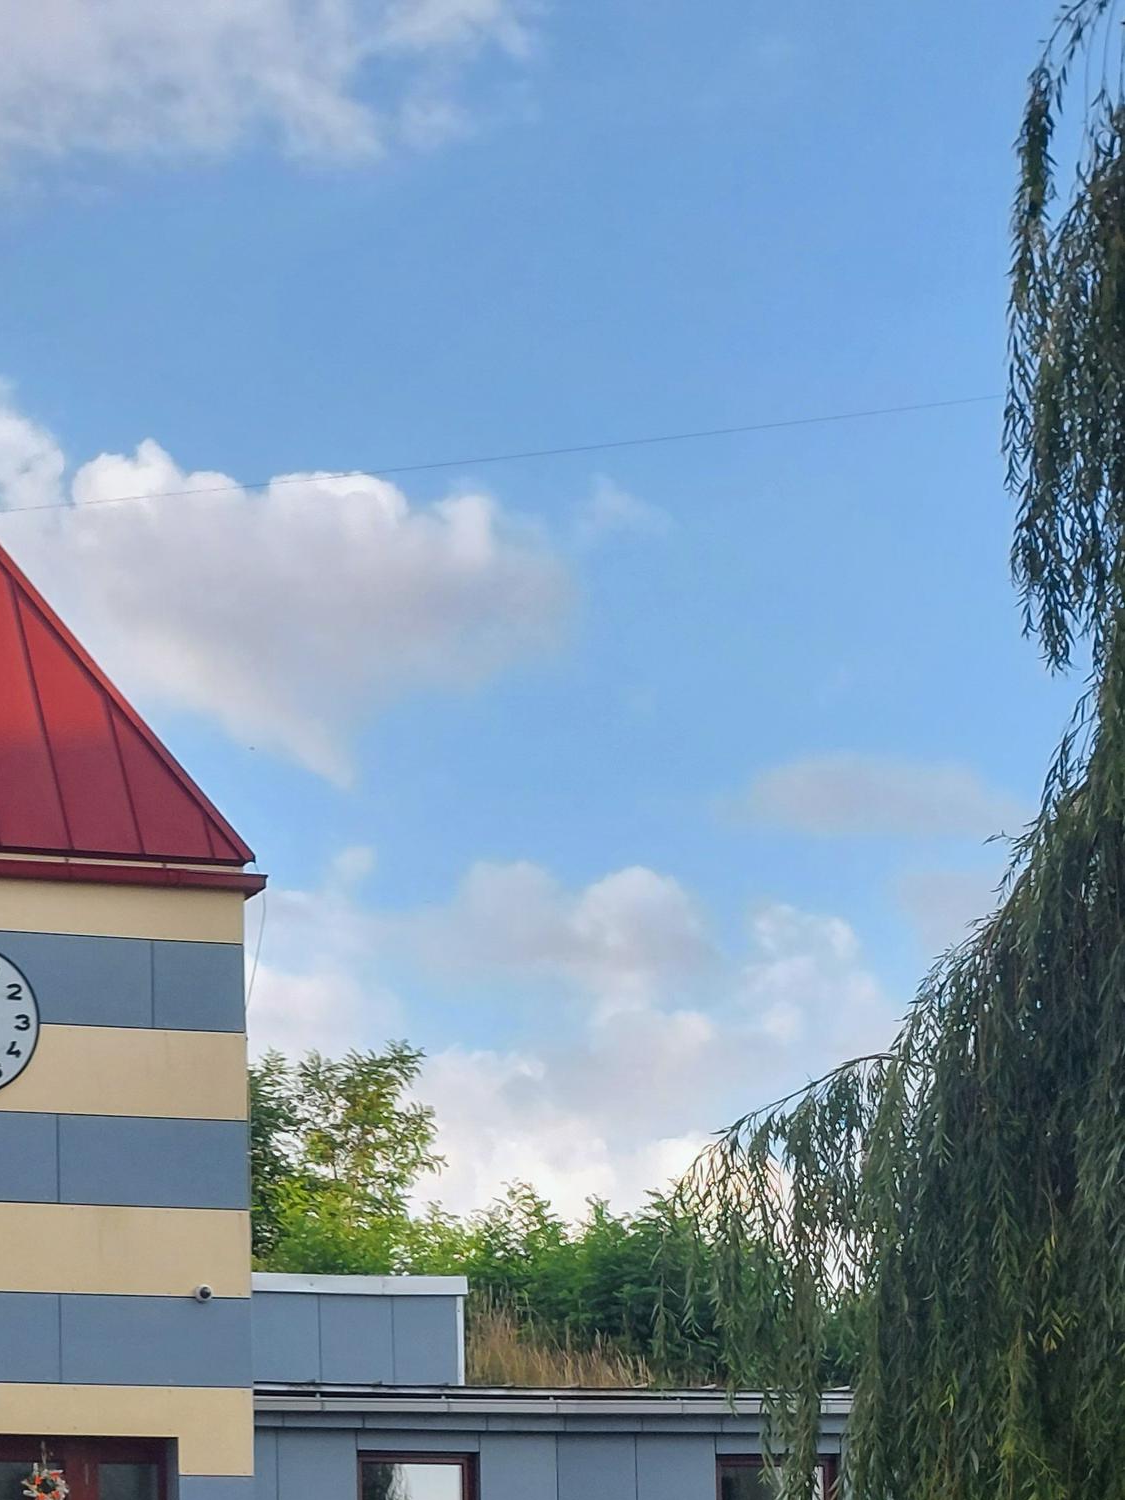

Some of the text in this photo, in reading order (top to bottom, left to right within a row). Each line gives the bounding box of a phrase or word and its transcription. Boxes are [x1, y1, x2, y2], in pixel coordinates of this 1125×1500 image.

[6, 984, 23, 1001] 2
[14, 1014, 31, 1031] 3
[6, 1041, 22, 1058] 4
